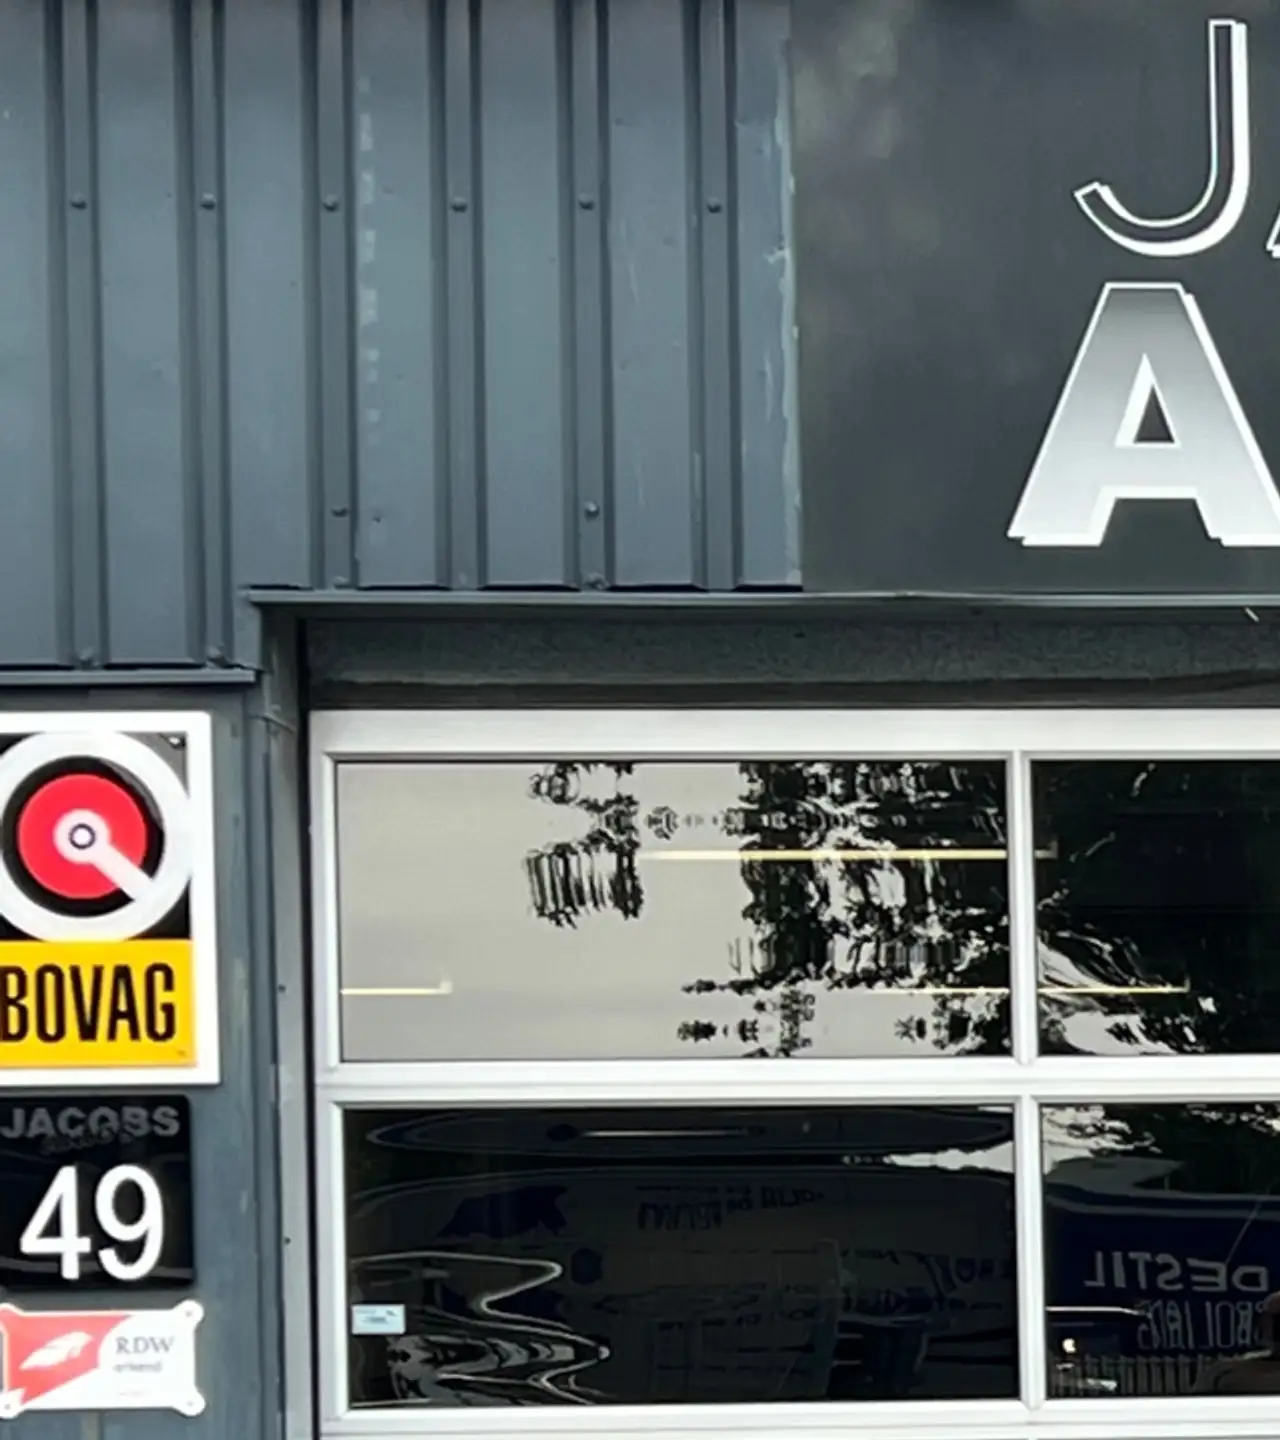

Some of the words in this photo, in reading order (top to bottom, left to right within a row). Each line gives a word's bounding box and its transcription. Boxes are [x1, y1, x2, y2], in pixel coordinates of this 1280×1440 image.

[0, 963, 176, 1043] BOVAG
[0, 1106, 180, 1138] JACOBS
[19, 1163, 164, 1281] 49
[115, 1336, 175, 1354] RDW
